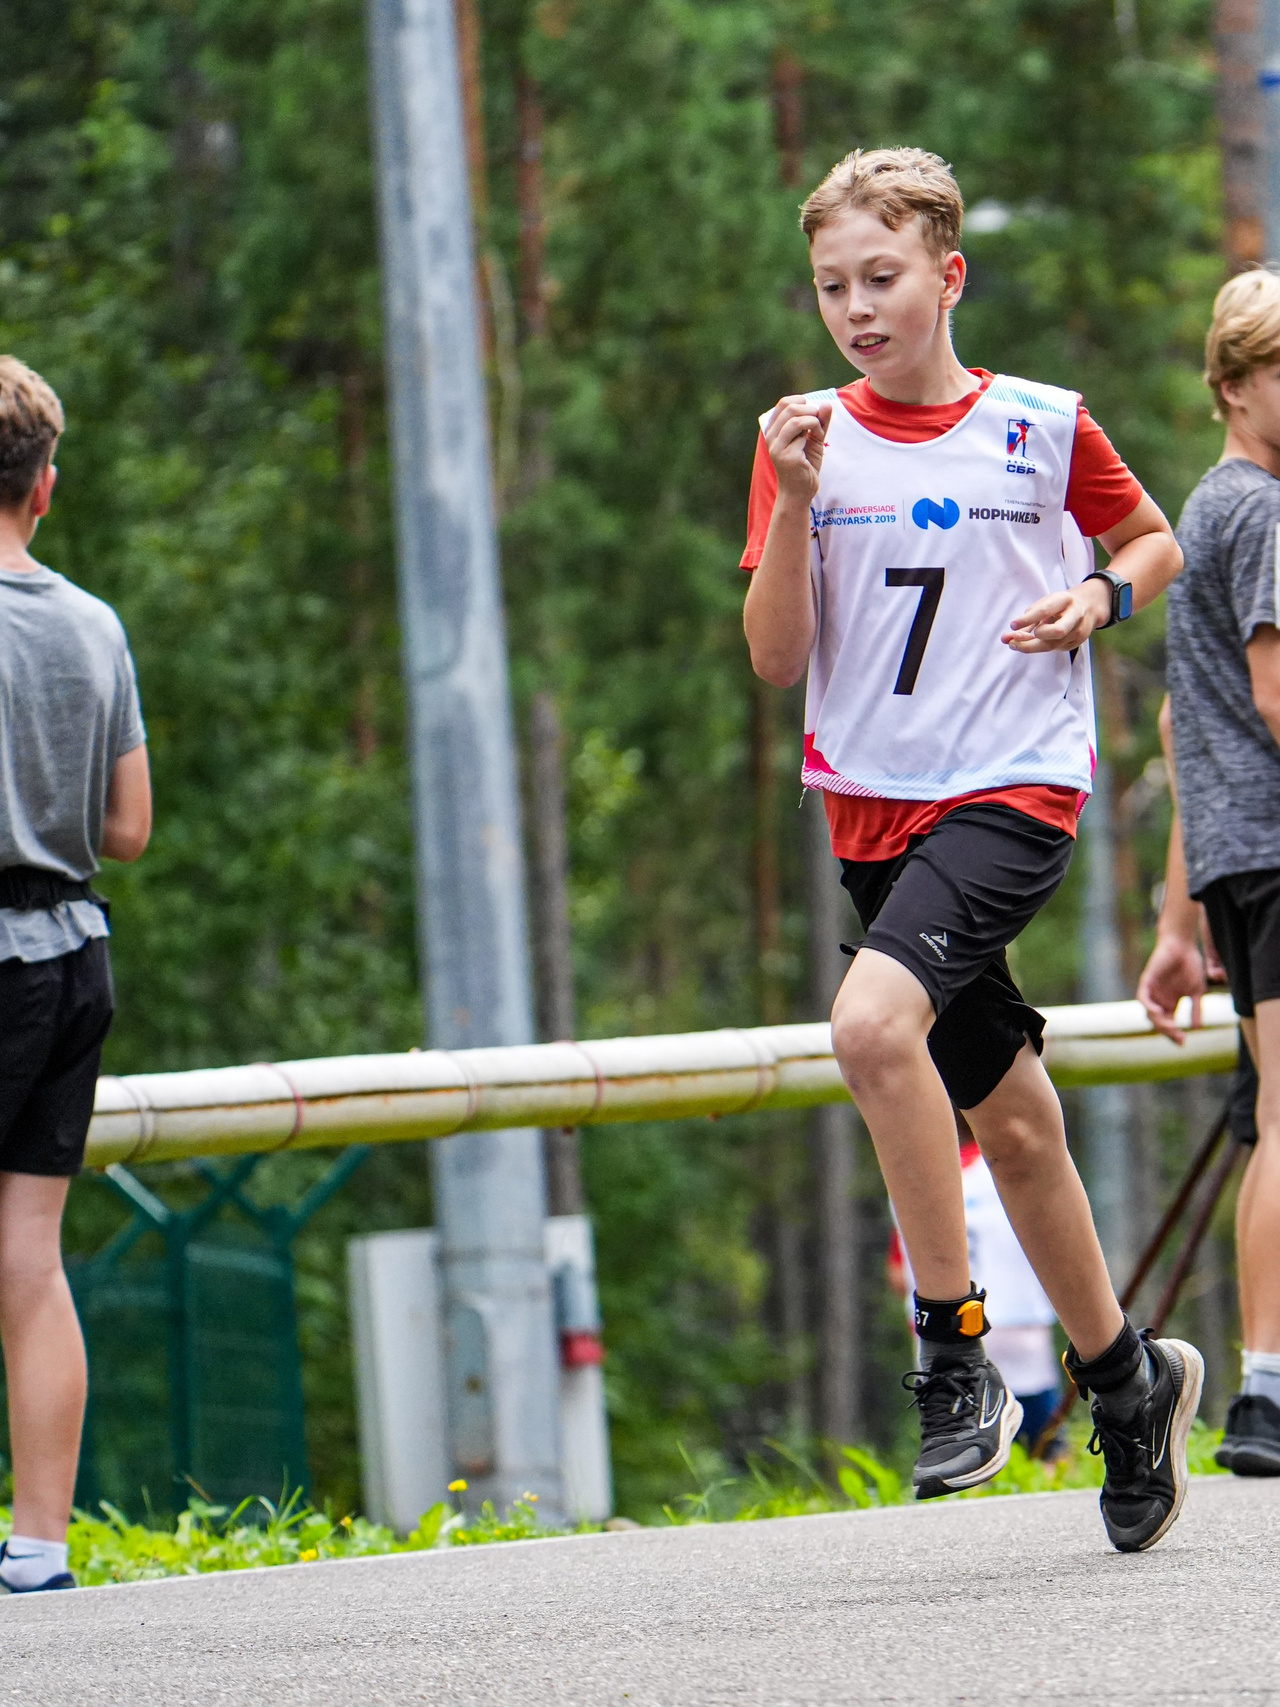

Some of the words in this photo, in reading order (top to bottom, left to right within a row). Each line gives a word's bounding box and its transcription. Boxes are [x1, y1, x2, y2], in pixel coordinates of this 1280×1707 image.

[1006, 464, 1036, 474] СБР
[845, 505, 896, 514] UNIVERSIADE
[968, 507, 1041, 524] НОРНИКЕЛЬ
[814, 516, 872, 528] KASNOYARSK
[875, 515, 896, 523] 2019
[885, 567, 945, 696] 7
[918, 932, 947, 962] DEMIX
